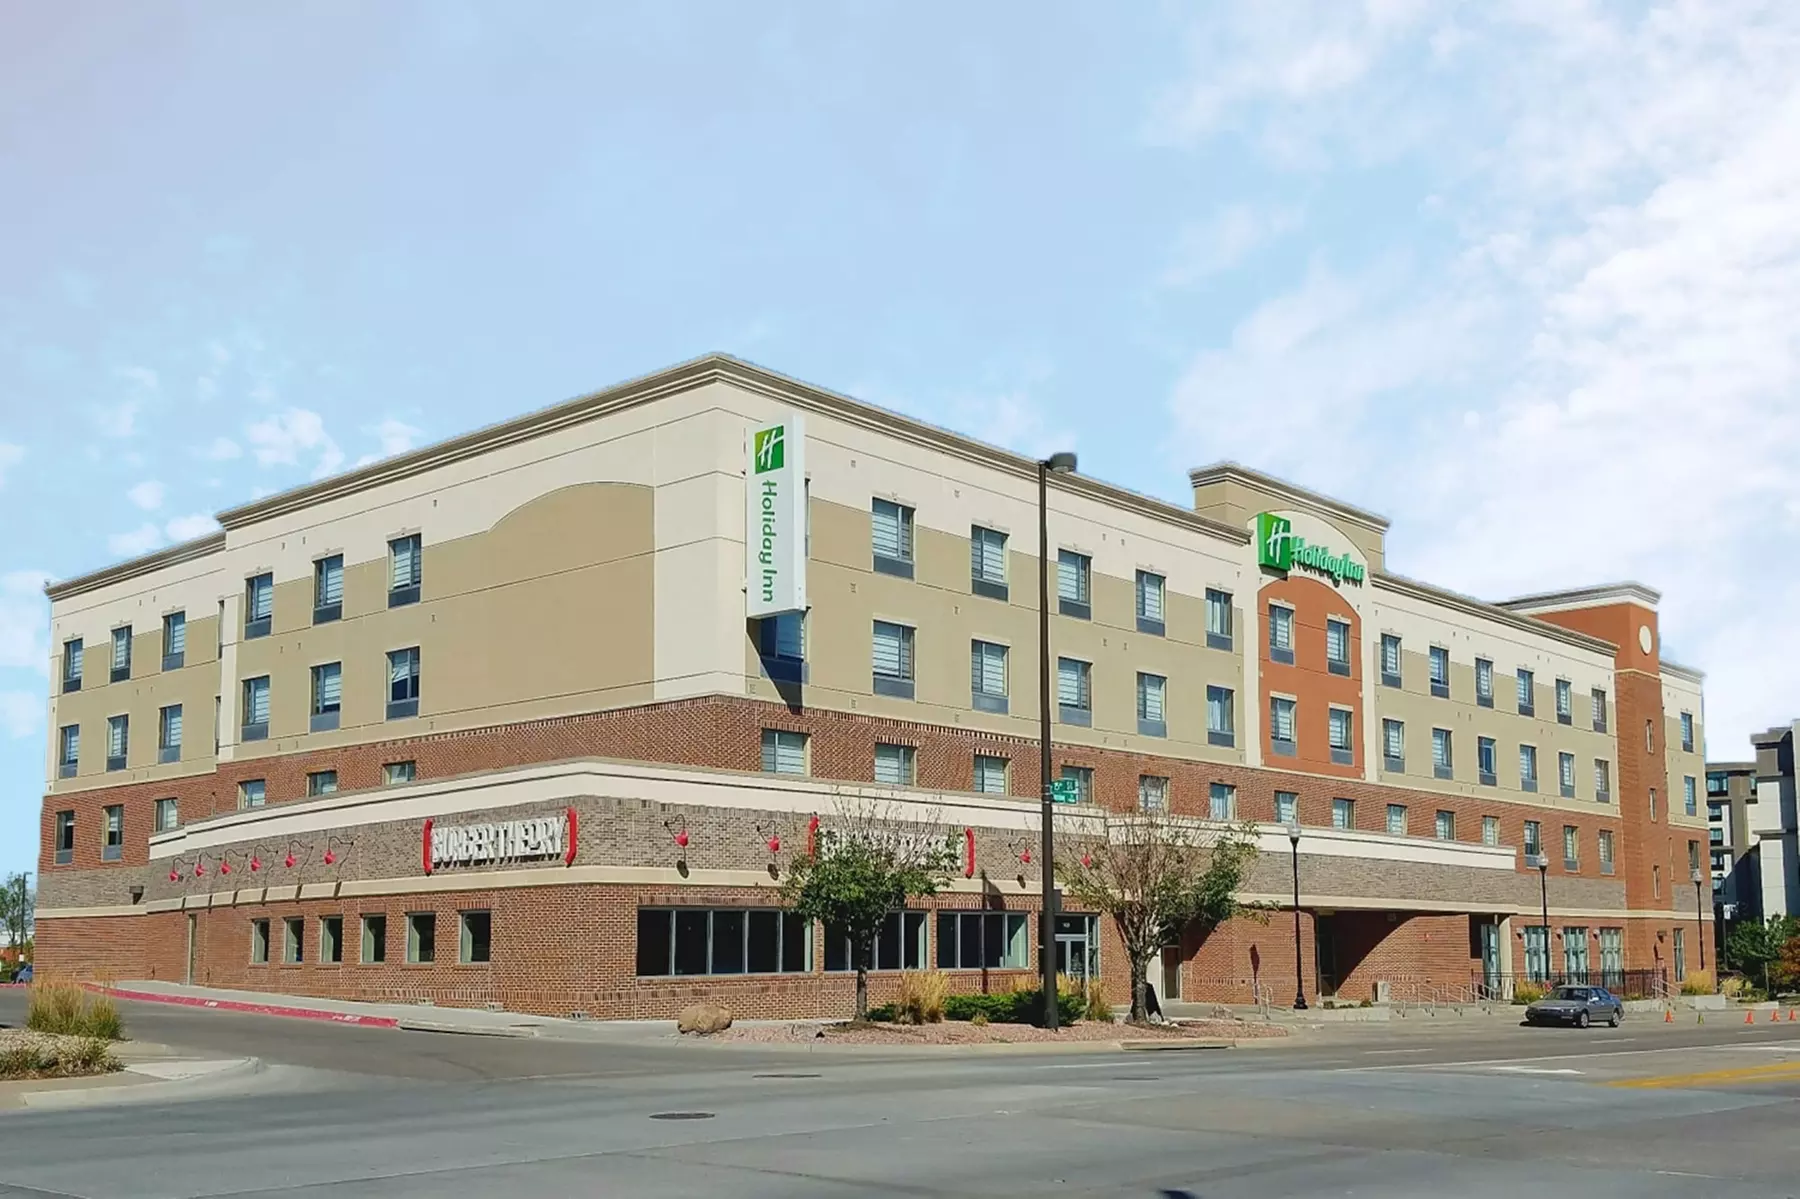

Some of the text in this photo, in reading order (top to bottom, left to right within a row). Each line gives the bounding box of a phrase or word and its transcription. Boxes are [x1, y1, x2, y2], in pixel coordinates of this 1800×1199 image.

[758, 479, 778, 602] Holiday Inn
[1291, 536, 1365, 582] Holiday Inn
